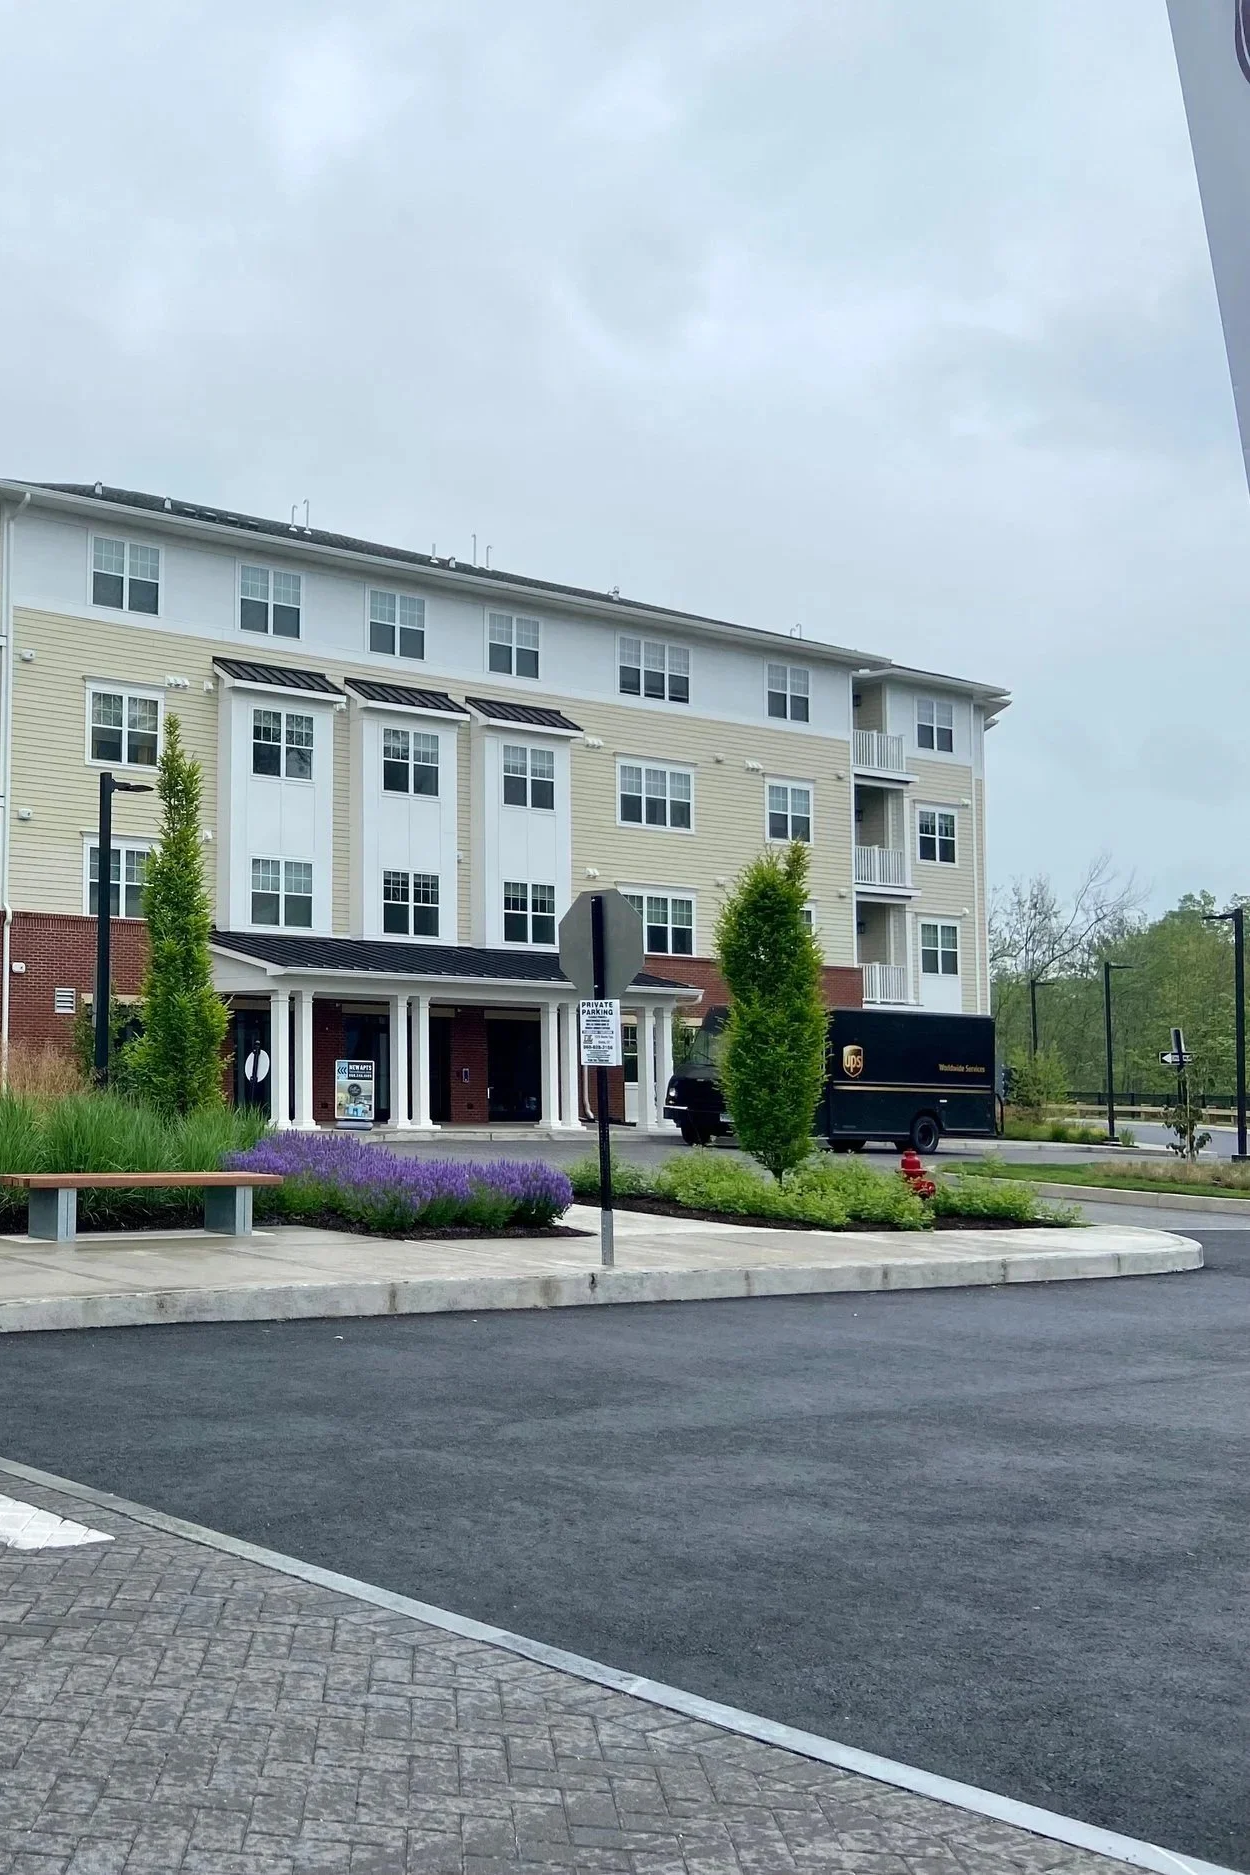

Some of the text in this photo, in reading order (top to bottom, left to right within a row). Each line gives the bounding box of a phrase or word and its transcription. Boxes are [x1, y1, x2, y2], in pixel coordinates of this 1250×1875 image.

[844, 1055, 862, 1073] ups
[938, 1063, 986, 1073] Worldwide Services
